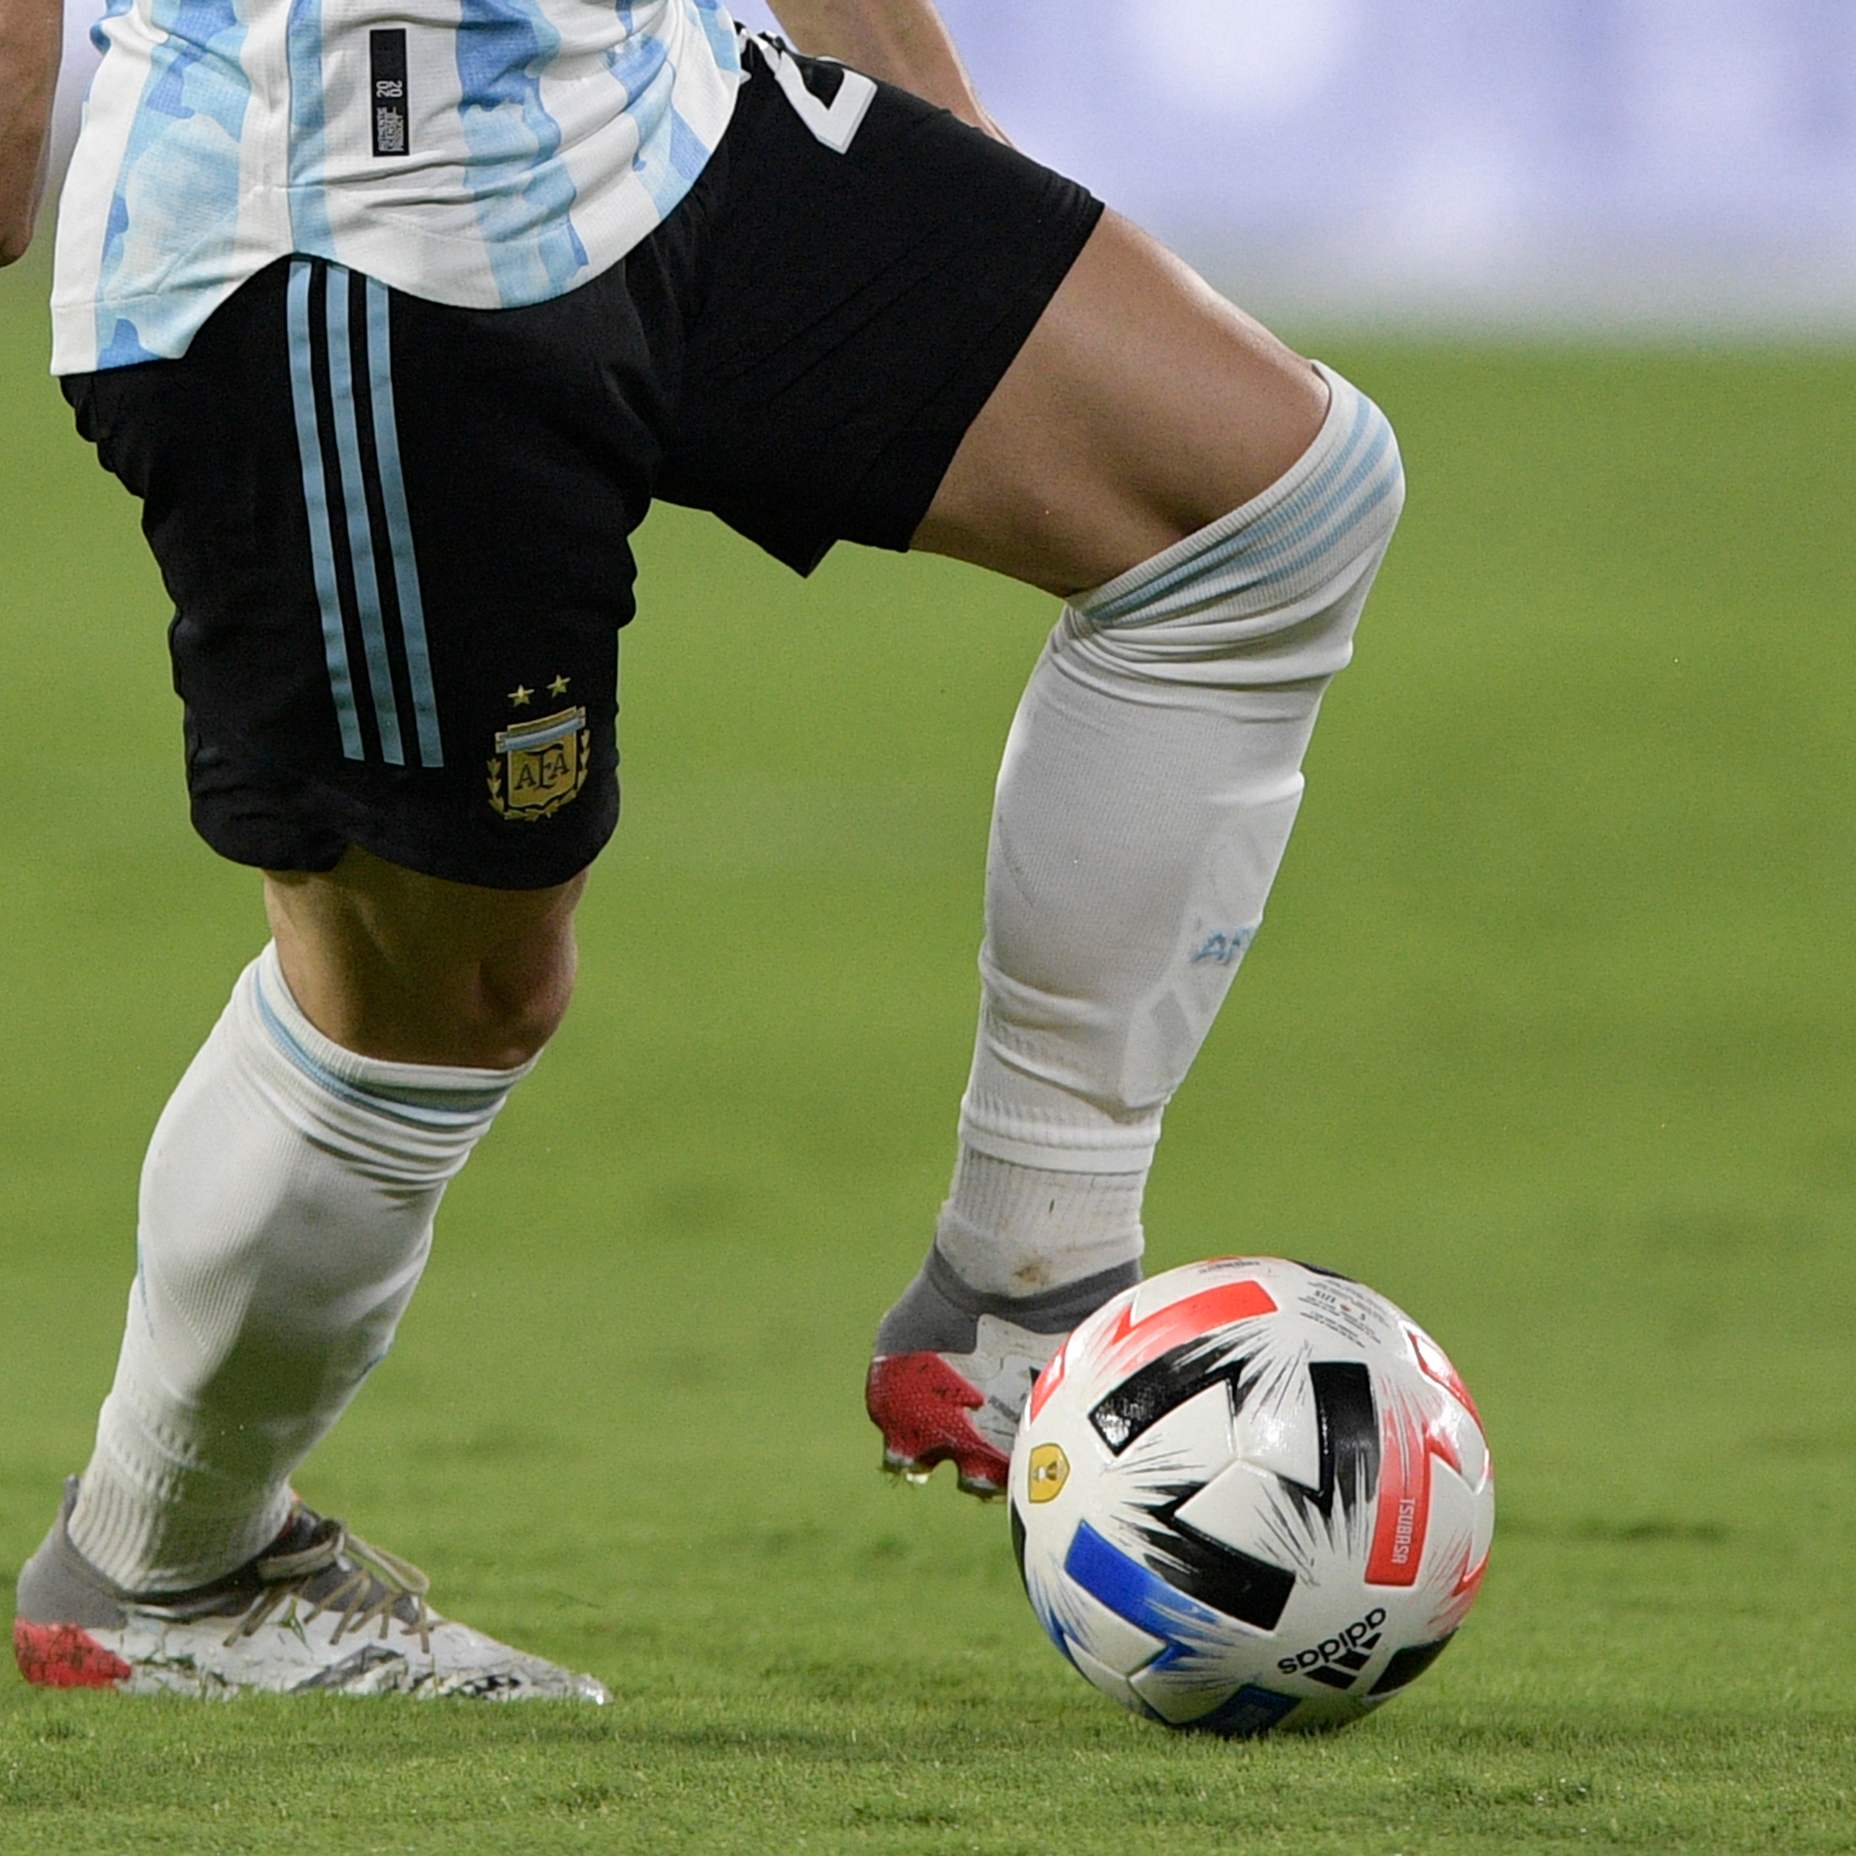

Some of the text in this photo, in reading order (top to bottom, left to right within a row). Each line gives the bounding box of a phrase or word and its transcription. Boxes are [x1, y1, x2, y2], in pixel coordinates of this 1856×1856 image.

[514, 744, 570, 790] AFA
[1391, 1497, 1416, 1564] TSUBASA
[1277, 1608, 1387, 1676] adidas
